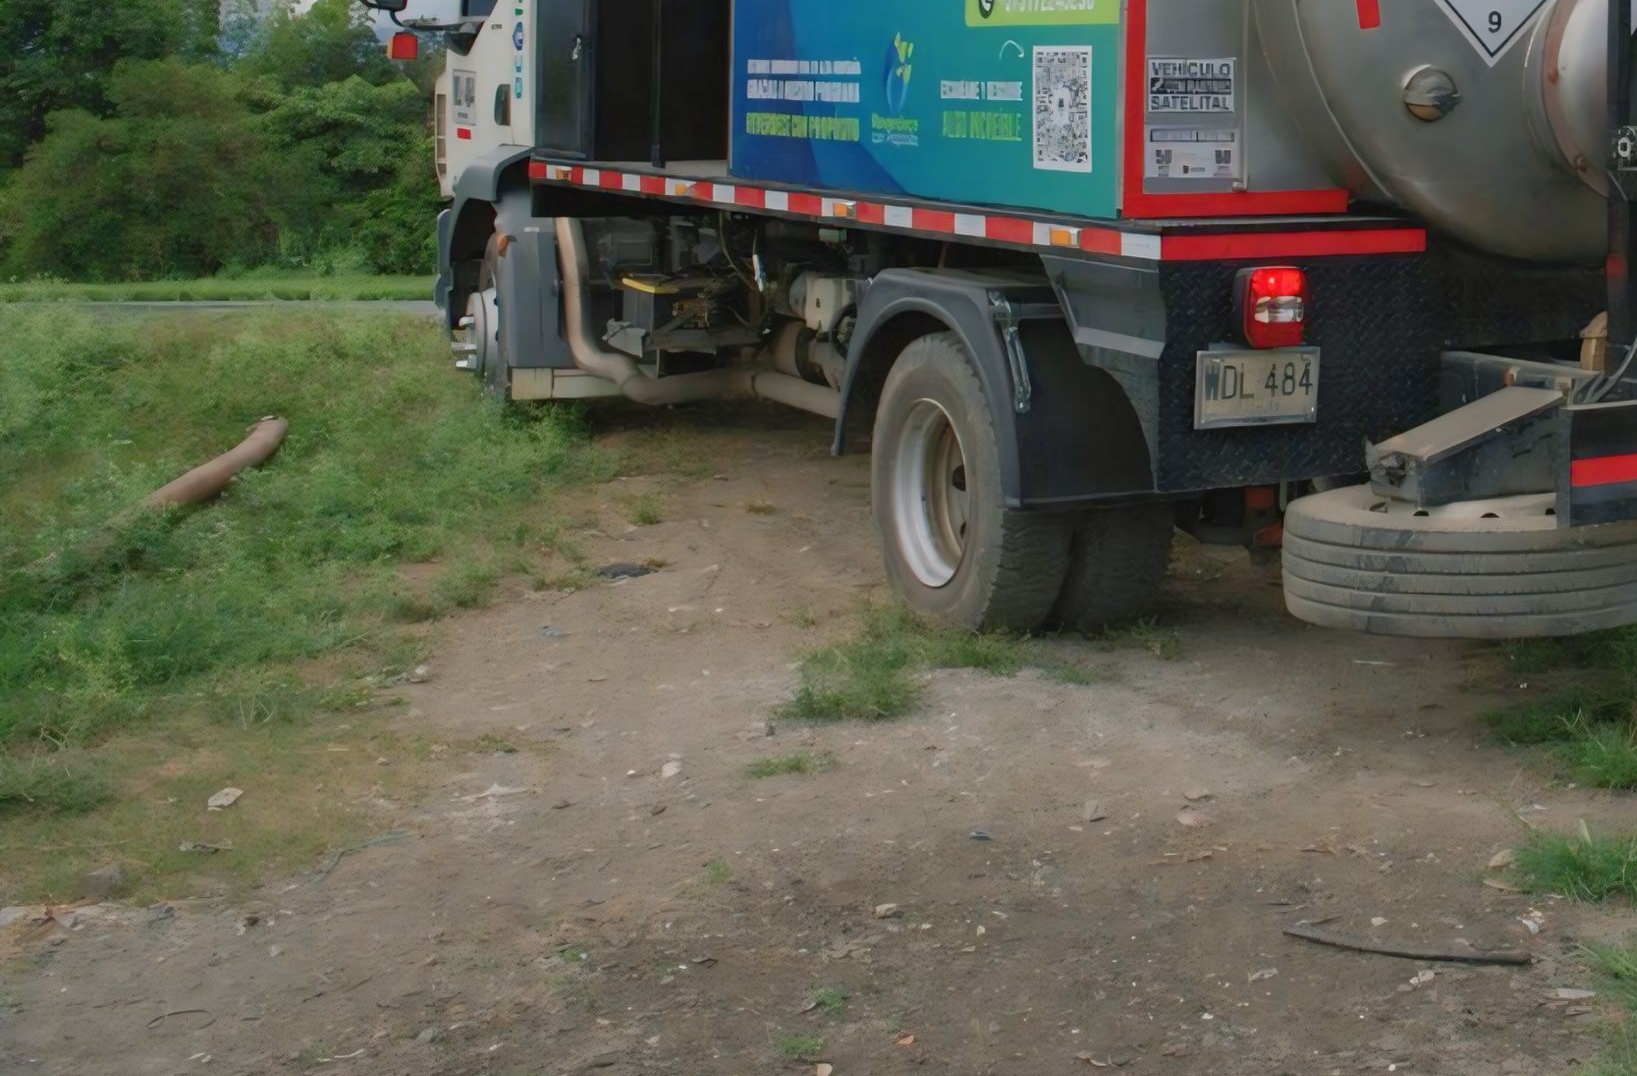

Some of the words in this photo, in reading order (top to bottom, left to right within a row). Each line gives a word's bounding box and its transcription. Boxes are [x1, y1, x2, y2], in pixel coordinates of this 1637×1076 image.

[1487, 10, 1502, 33] 9
[1151, 96, 1230, 110] SATELITAL
[1204, 362, 1255, 401] WDL
[1264, 361, 1313, 397] 484
